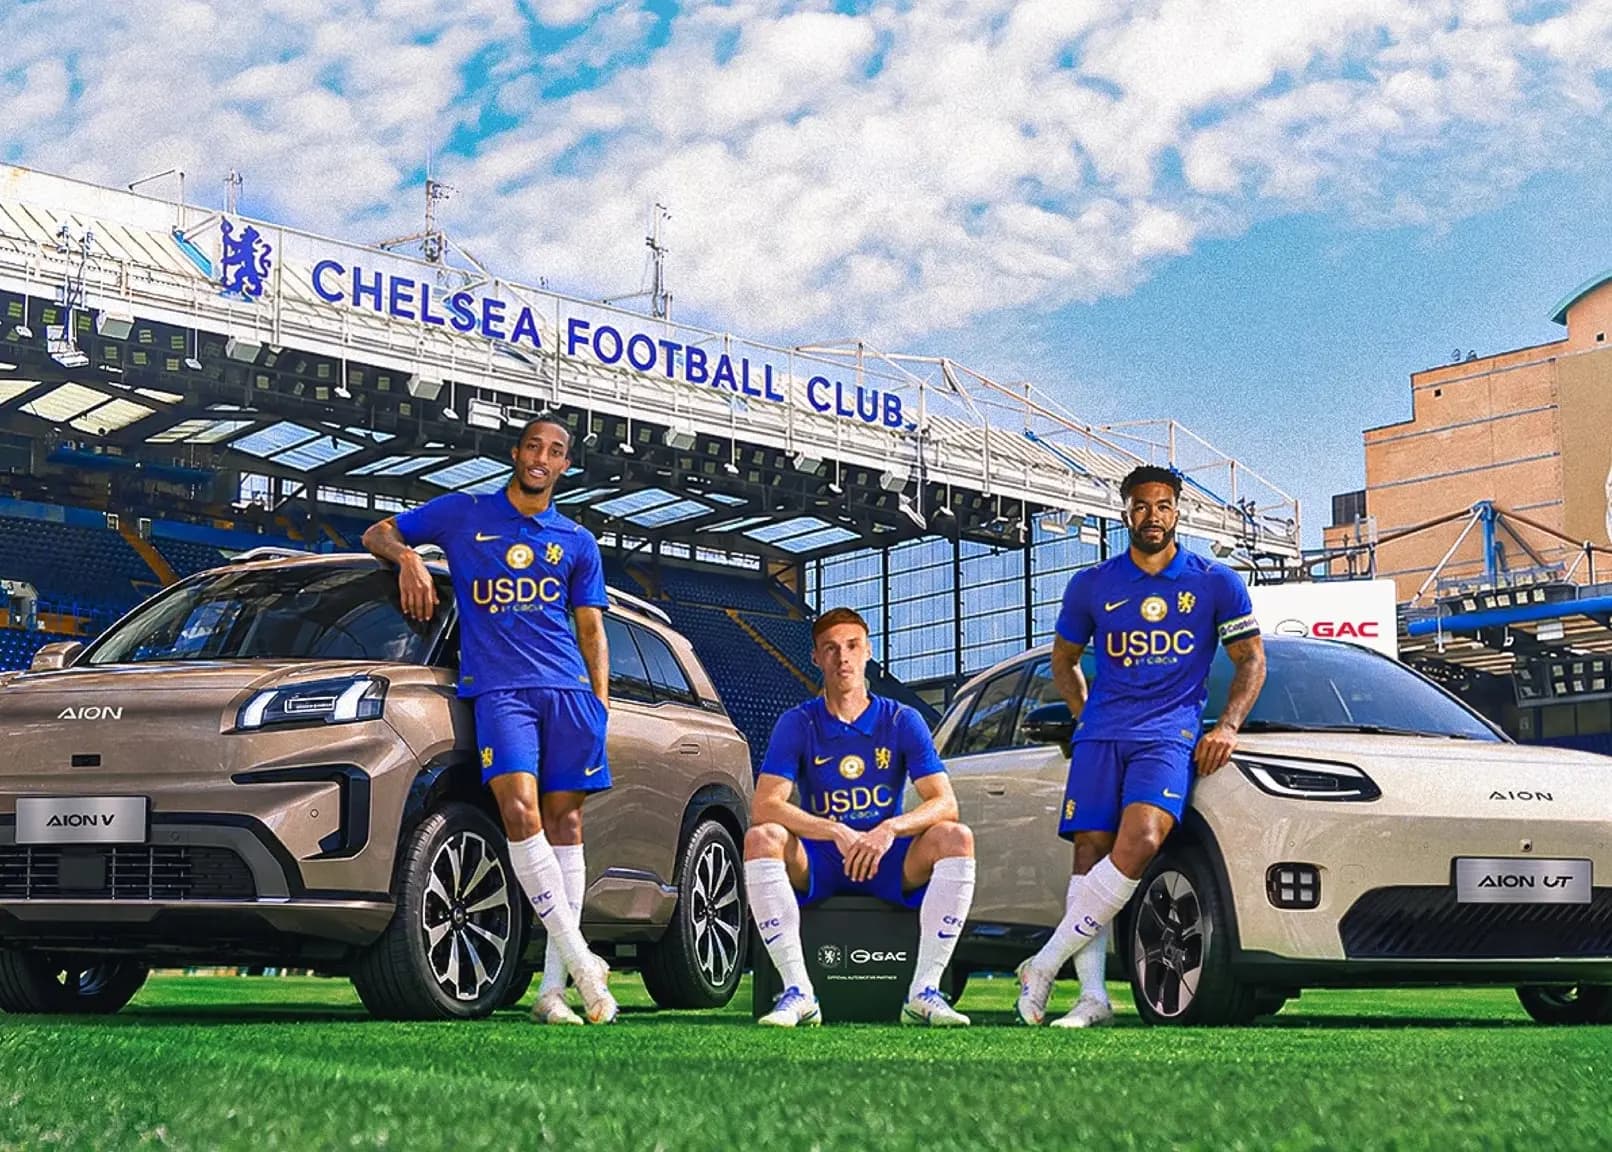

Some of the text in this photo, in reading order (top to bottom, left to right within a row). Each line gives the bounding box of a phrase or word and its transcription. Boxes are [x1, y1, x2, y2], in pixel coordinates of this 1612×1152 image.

[311, 259, 904, 429] CHELSEA FOOTBALL CLUB
[473, 577, 561, 605] USDC
[1312, 621, 1379, 638] GAC
[1107, 629, 1195, 657] USDC
[57, 706, 124, 720] AION
[811, 784, 893, 815] USDC
[1488, 790, 1554, 802] AION
[46, 814, 116, 827] AION V
[1477, 875, 1574, 888] AION UT
[871, 951, 907, 961] GAC
